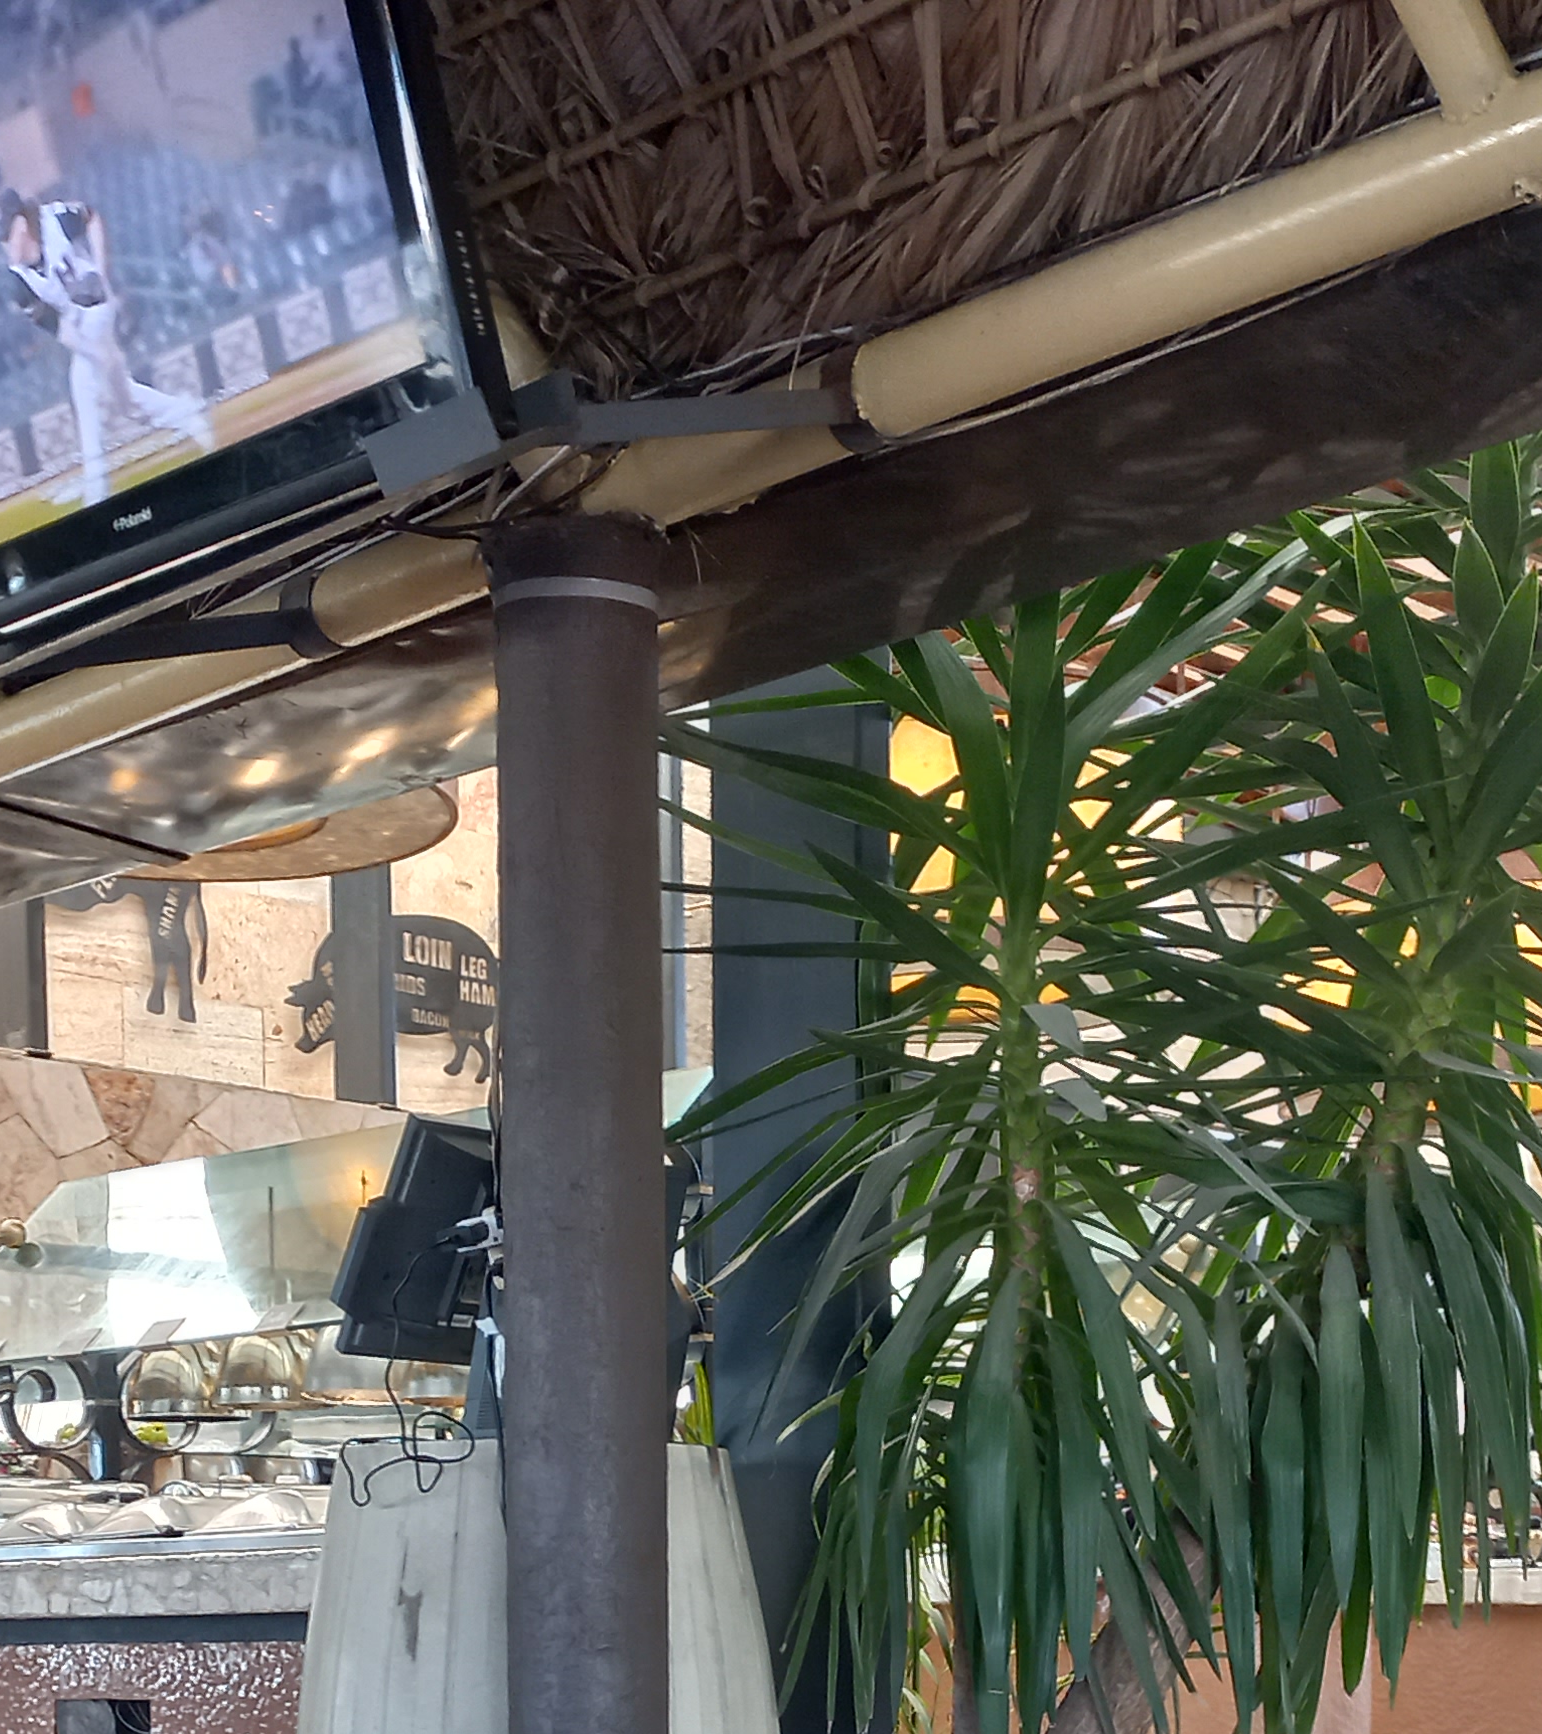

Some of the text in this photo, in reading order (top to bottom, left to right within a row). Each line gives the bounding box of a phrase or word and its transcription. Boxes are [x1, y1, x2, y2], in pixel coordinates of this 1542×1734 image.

[402, 931, 452, 970] LOIN
[460, 954, 488, 981] LEG
[460, 979, 496, 1007] HAM
[411, 1007, 450, 1028] BACON
